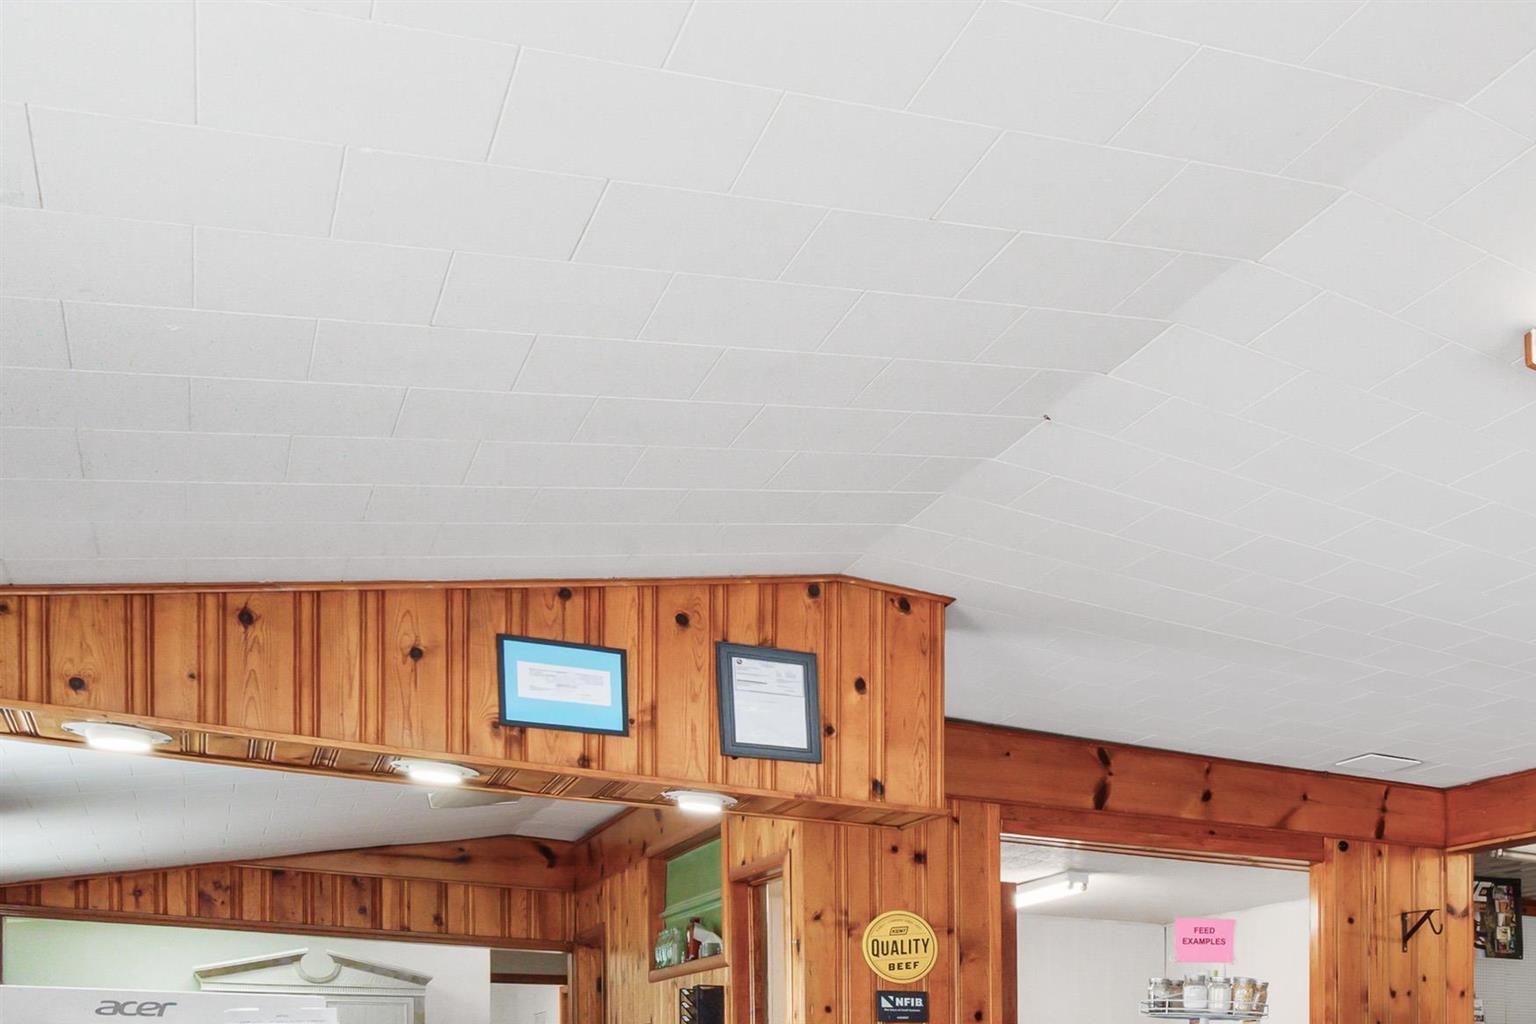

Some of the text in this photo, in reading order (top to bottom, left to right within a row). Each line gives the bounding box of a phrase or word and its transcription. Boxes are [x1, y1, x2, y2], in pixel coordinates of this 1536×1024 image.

[1193, 926, 1216, 934] FEED
[871, 938, 930, 958] QUALITY
[888, 961, 920, 971] BEEF
[895, 997, 924, 1007] NFIB
[95, 1000, 177, 1017] acer
